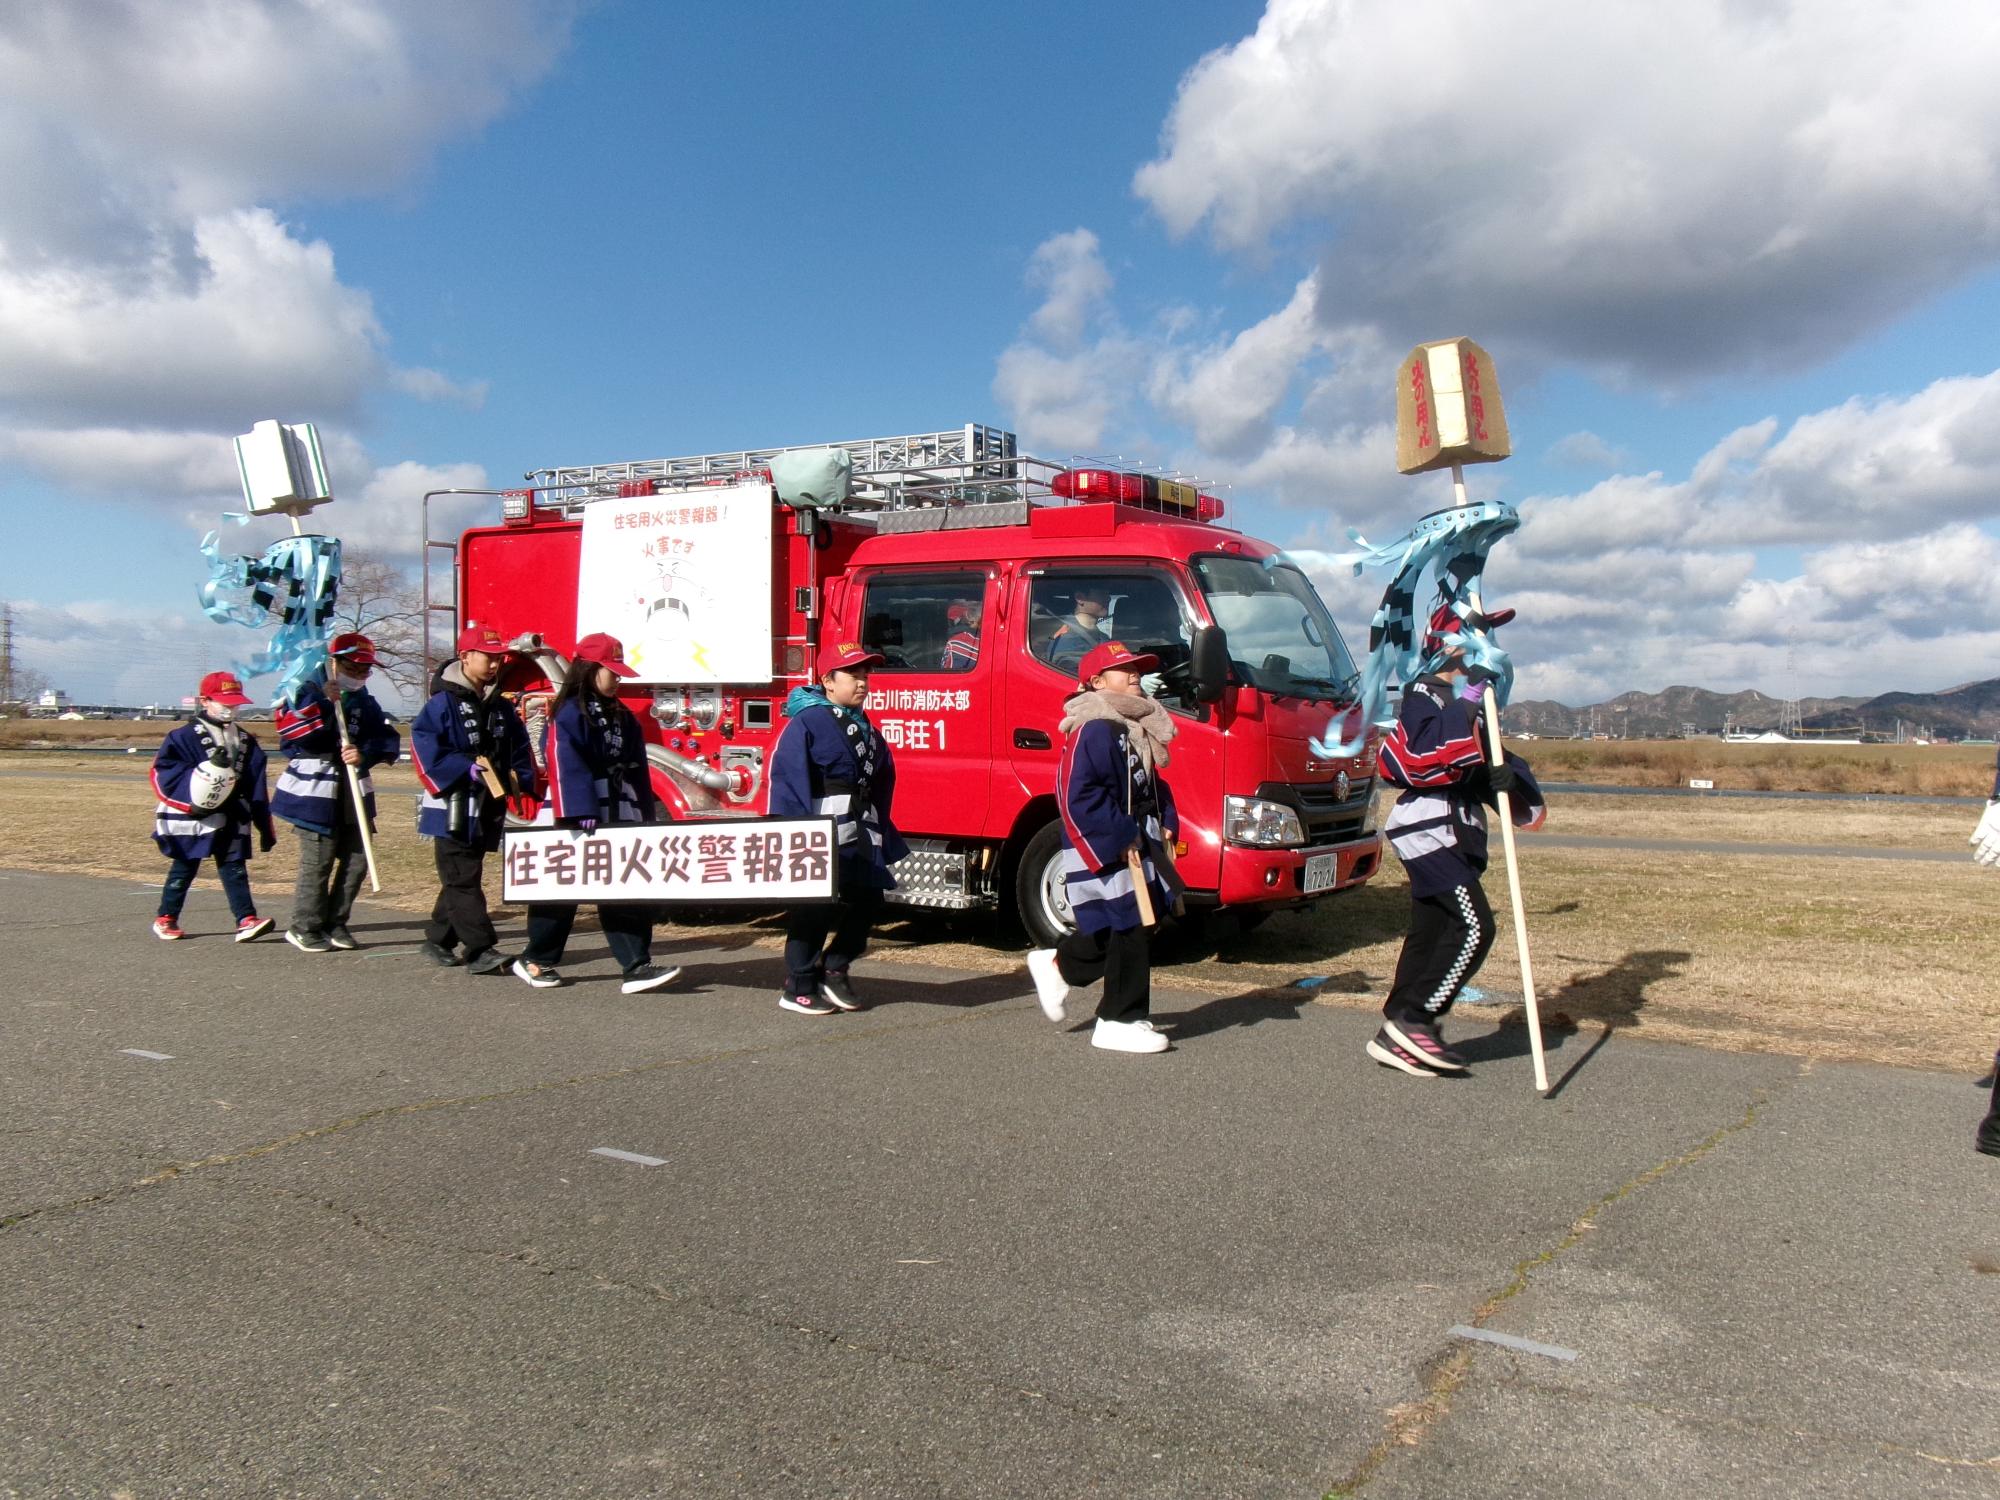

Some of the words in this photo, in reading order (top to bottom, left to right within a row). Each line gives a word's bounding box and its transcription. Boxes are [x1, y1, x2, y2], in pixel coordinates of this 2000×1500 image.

[641, 535, 695, 558] 火事です
[880, 719, 945, 750] 両荘1
[200, 776, 226, 809] 火の用心
[505, 831, 829, 886] 住宅用火災警報器
